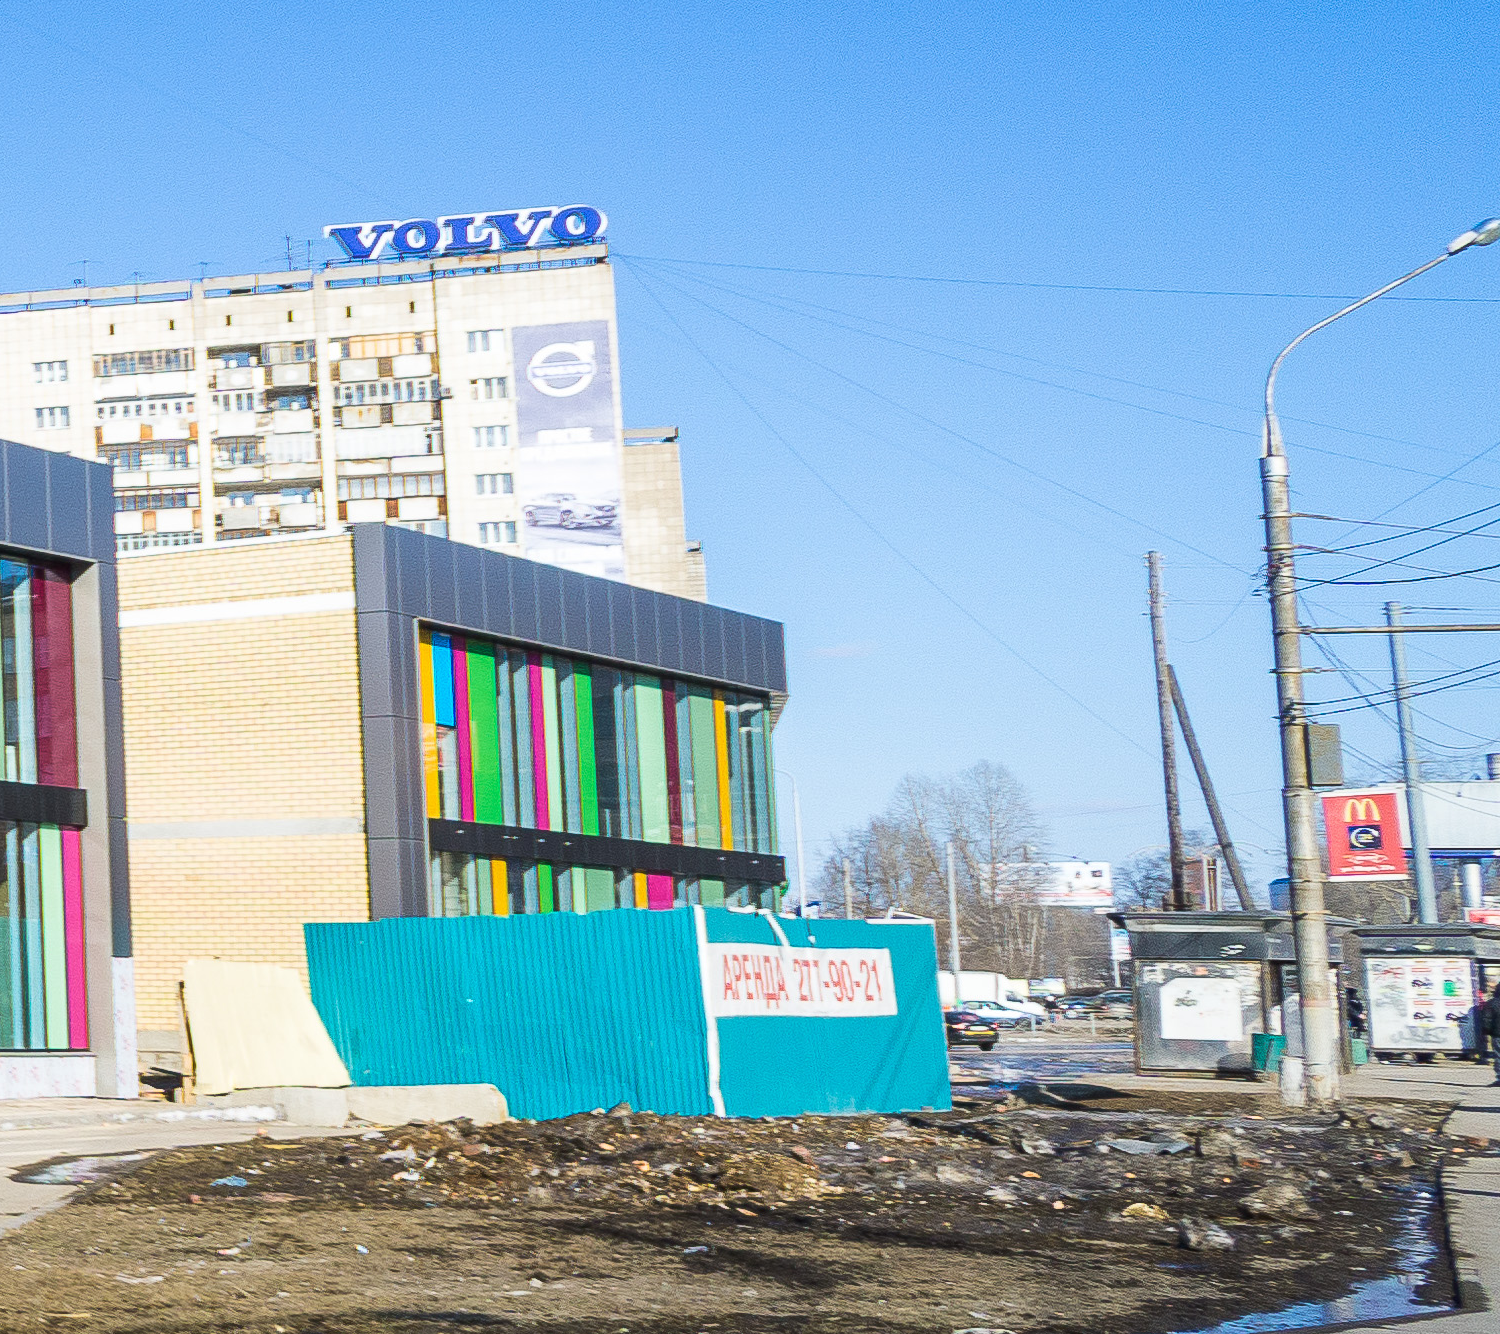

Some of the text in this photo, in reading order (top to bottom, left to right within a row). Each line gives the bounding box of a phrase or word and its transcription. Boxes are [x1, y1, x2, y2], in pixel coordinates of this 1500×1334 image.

[327, 205, 605, 259] VOLVO
[722, 954, 883, 1009] АРЕНДА 277-90-21
